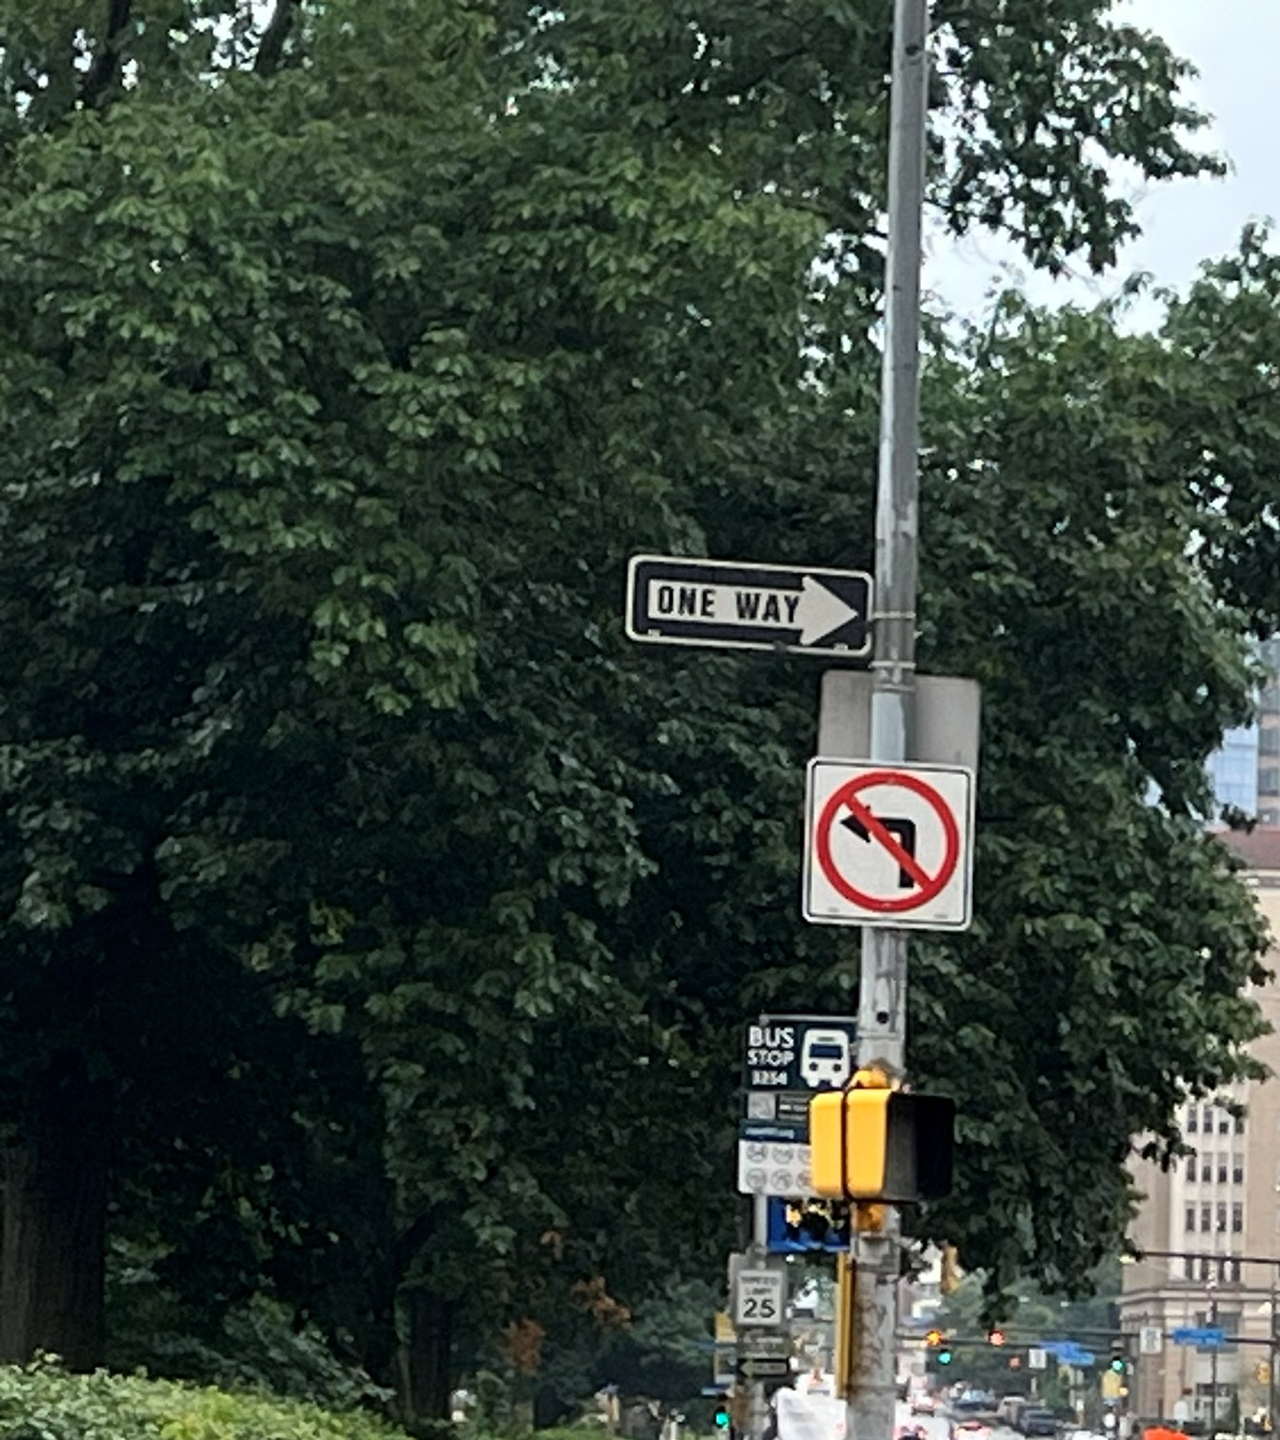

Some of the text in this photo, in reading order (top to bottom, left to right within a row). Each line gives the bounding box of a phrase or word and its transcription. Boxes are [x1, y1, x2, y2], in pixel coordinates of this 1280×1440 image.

[657, 585, 800, 623] ONE WAY
[749, 1025, 795, 1048] BUS
[747, 1048, 795, 1067] STOP
[743, 1297, 776, 1318] 25
